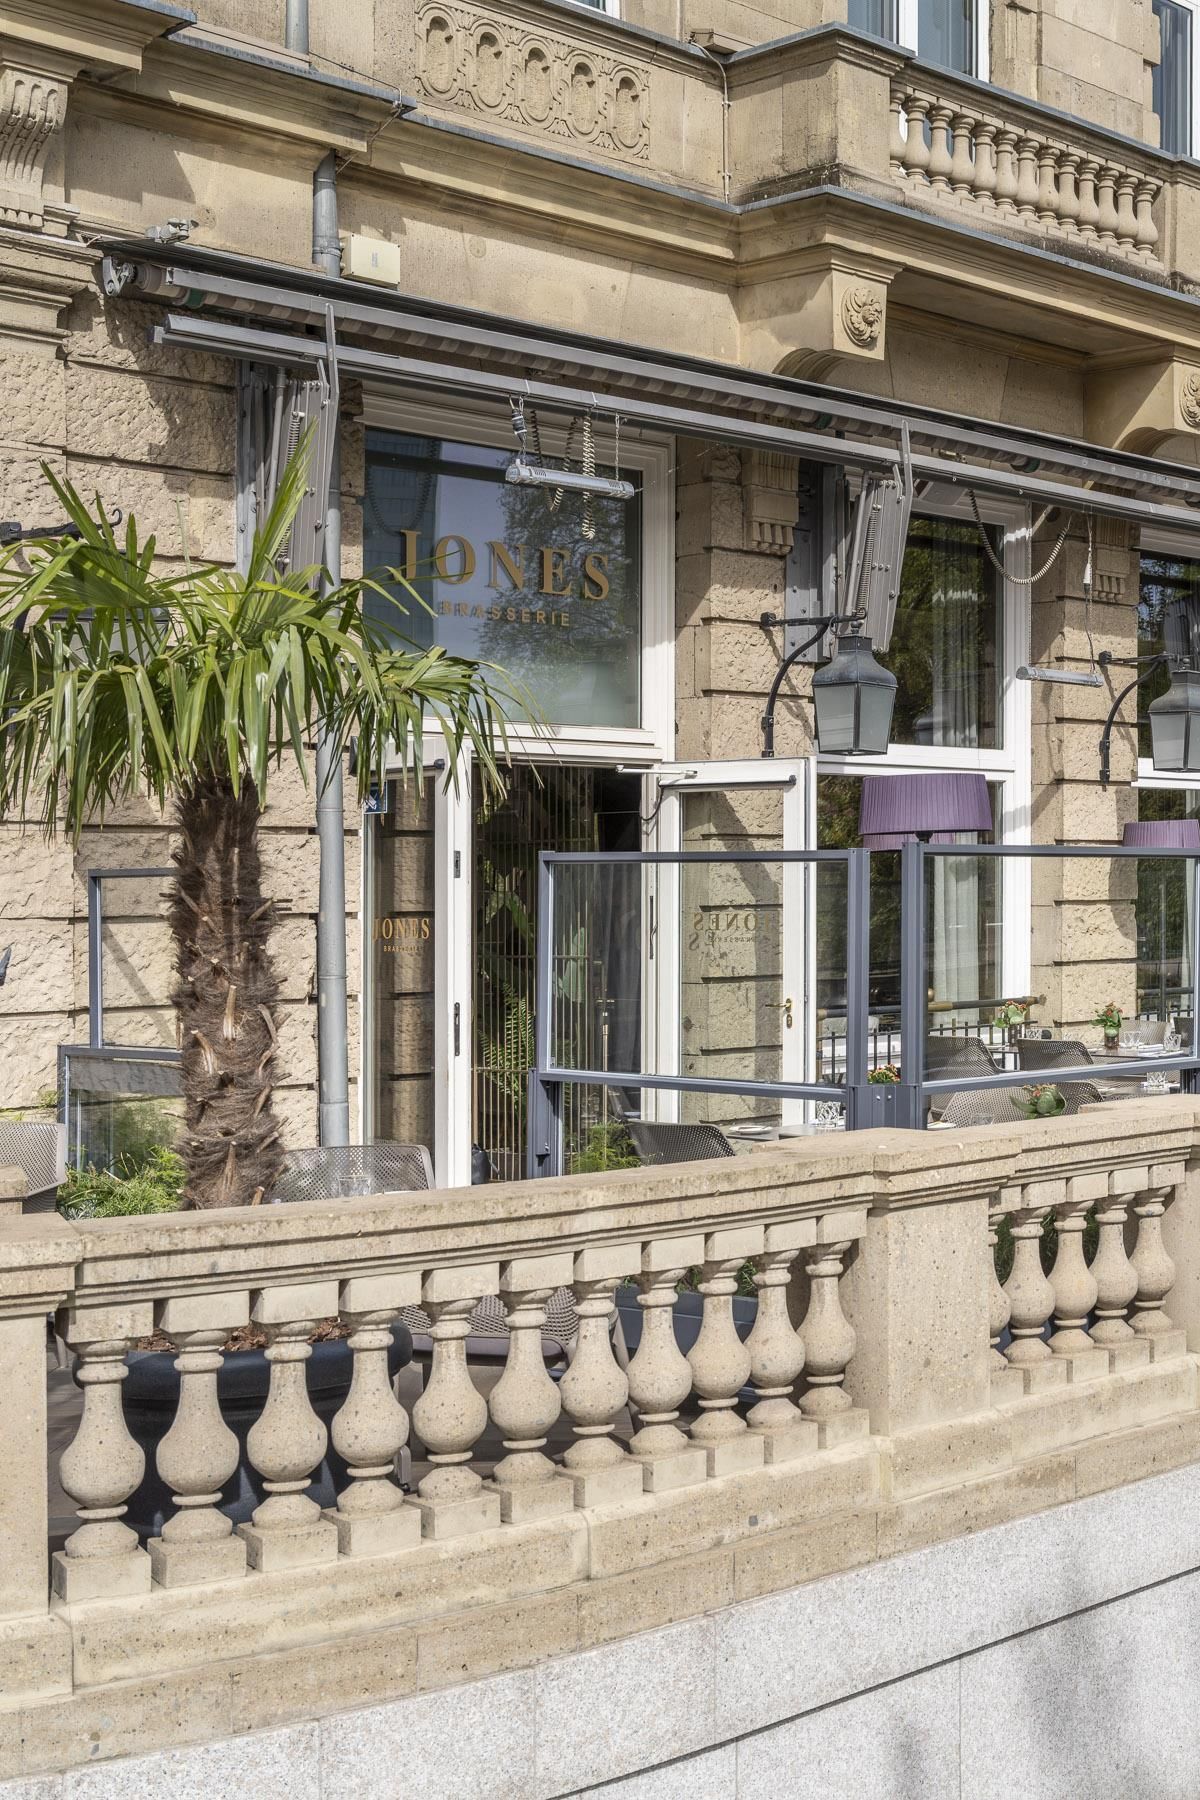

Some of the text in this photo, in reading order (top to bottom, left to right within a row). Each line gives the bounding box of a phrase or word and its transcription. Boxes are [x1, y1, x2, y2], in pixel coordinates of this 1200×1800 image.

[400, 528, 611, 601] JONES
[438, 599, 571, 627] BRASSERIE
[372, 918, 430, 943] JONES
